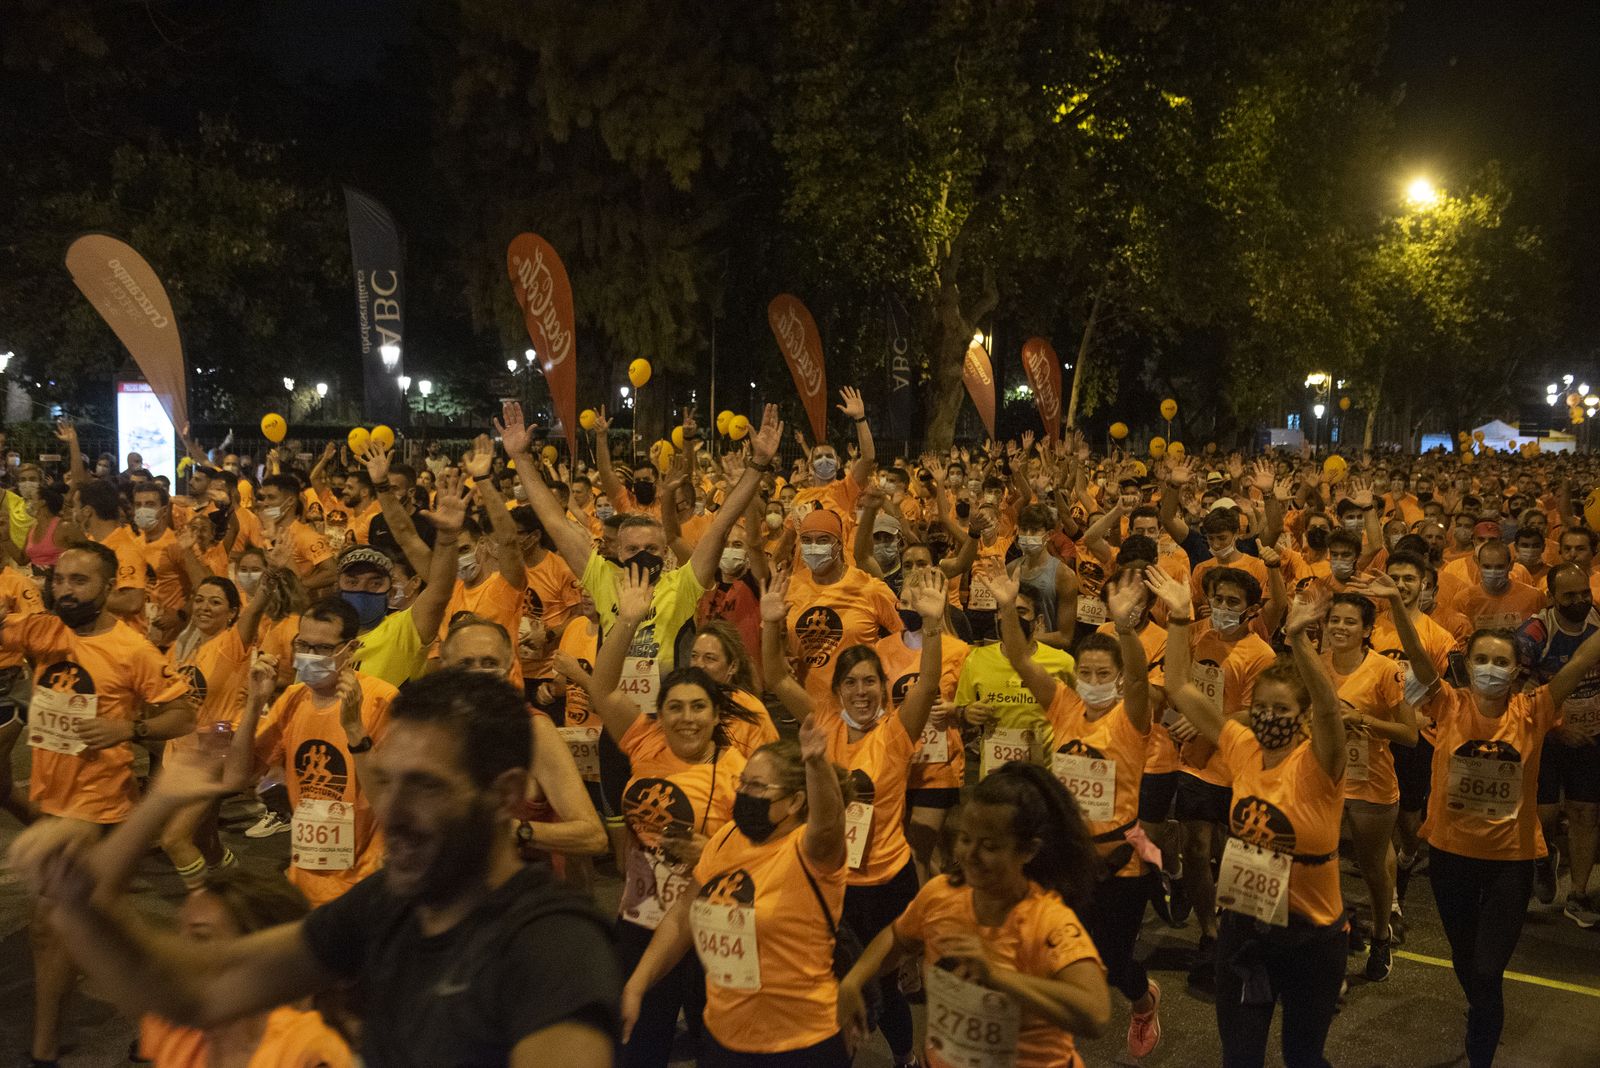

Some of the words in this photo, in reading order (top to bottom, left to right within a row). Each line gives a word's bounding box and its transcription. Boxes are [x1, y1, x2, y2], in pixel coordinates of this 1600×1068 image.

[974, 588, 993, 599] 225
[619, 679, 650, 694] 443
[1191, 677, 1215, 697] 716
[38, 711, 83, 734] 1765
[994, 745, 1032, 761] 8281
[1349, 748, 1360, 762] 9
[1459, 777, 1510, 799] 5648
[296, 822, 340, 844] 3361
[845, 826, 856, 844] 4
[1232, 865, 1280, 898] 7288
[937, 1004, 1001, 1045] 2788
